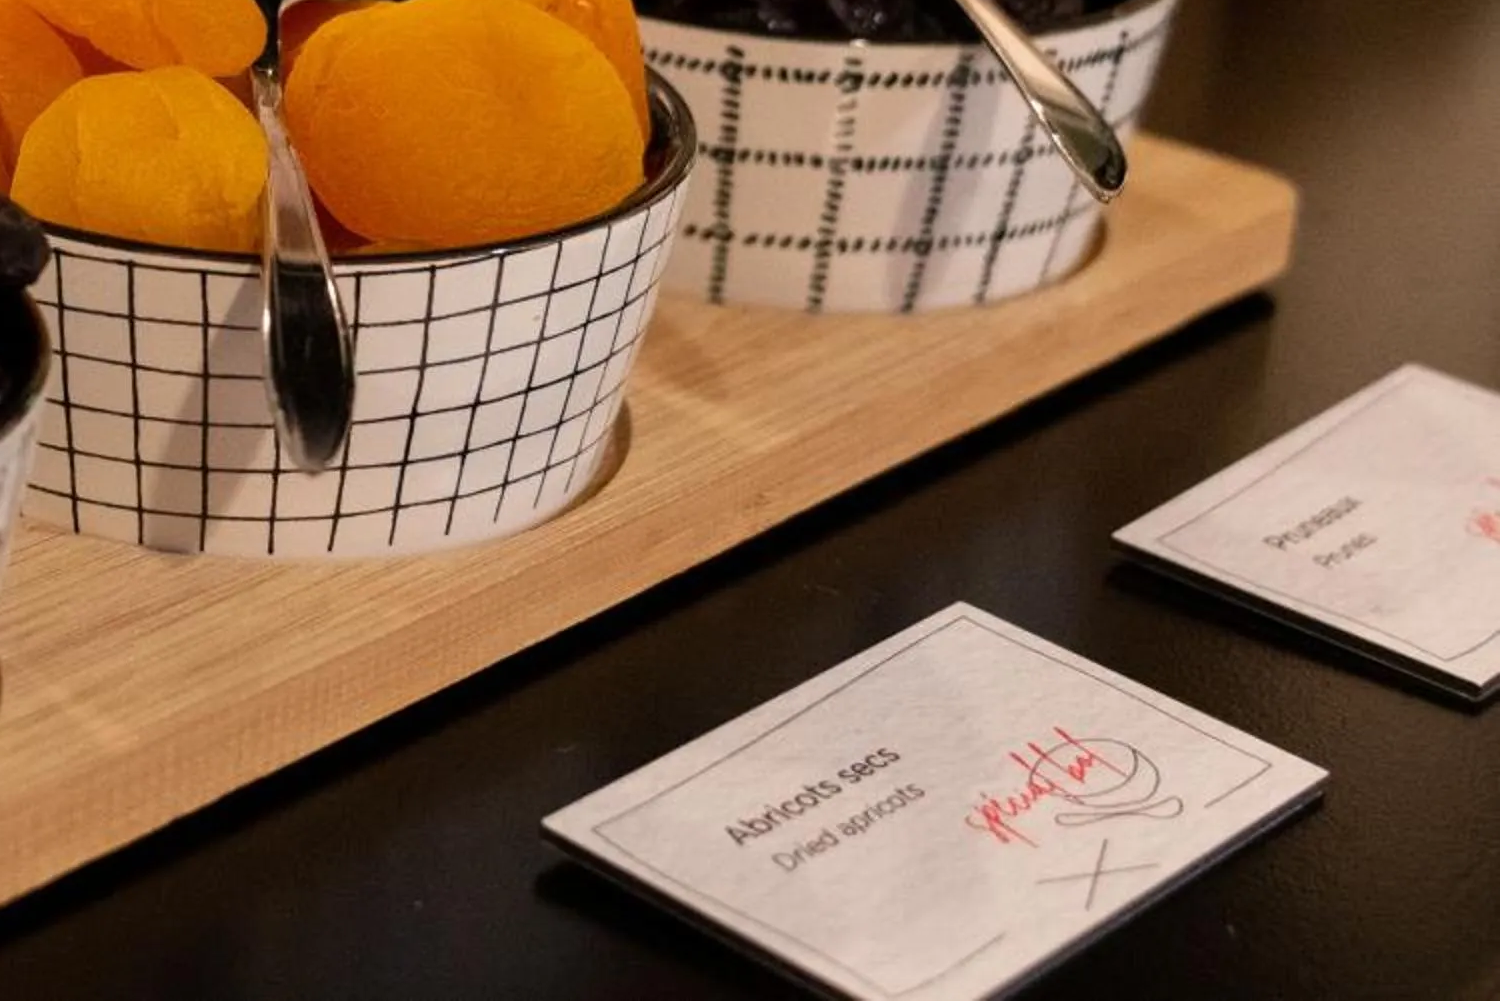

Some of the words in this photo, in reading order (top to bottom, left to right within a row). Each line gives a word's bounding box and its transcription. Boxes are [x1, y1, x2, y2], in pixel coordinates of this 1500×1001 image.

[723, 778, 843, 847] Abricots
[837, 747, 901, 785] secs
[770, 827, 840, 873] Dried
[836, 782, 926, 837] apricots
